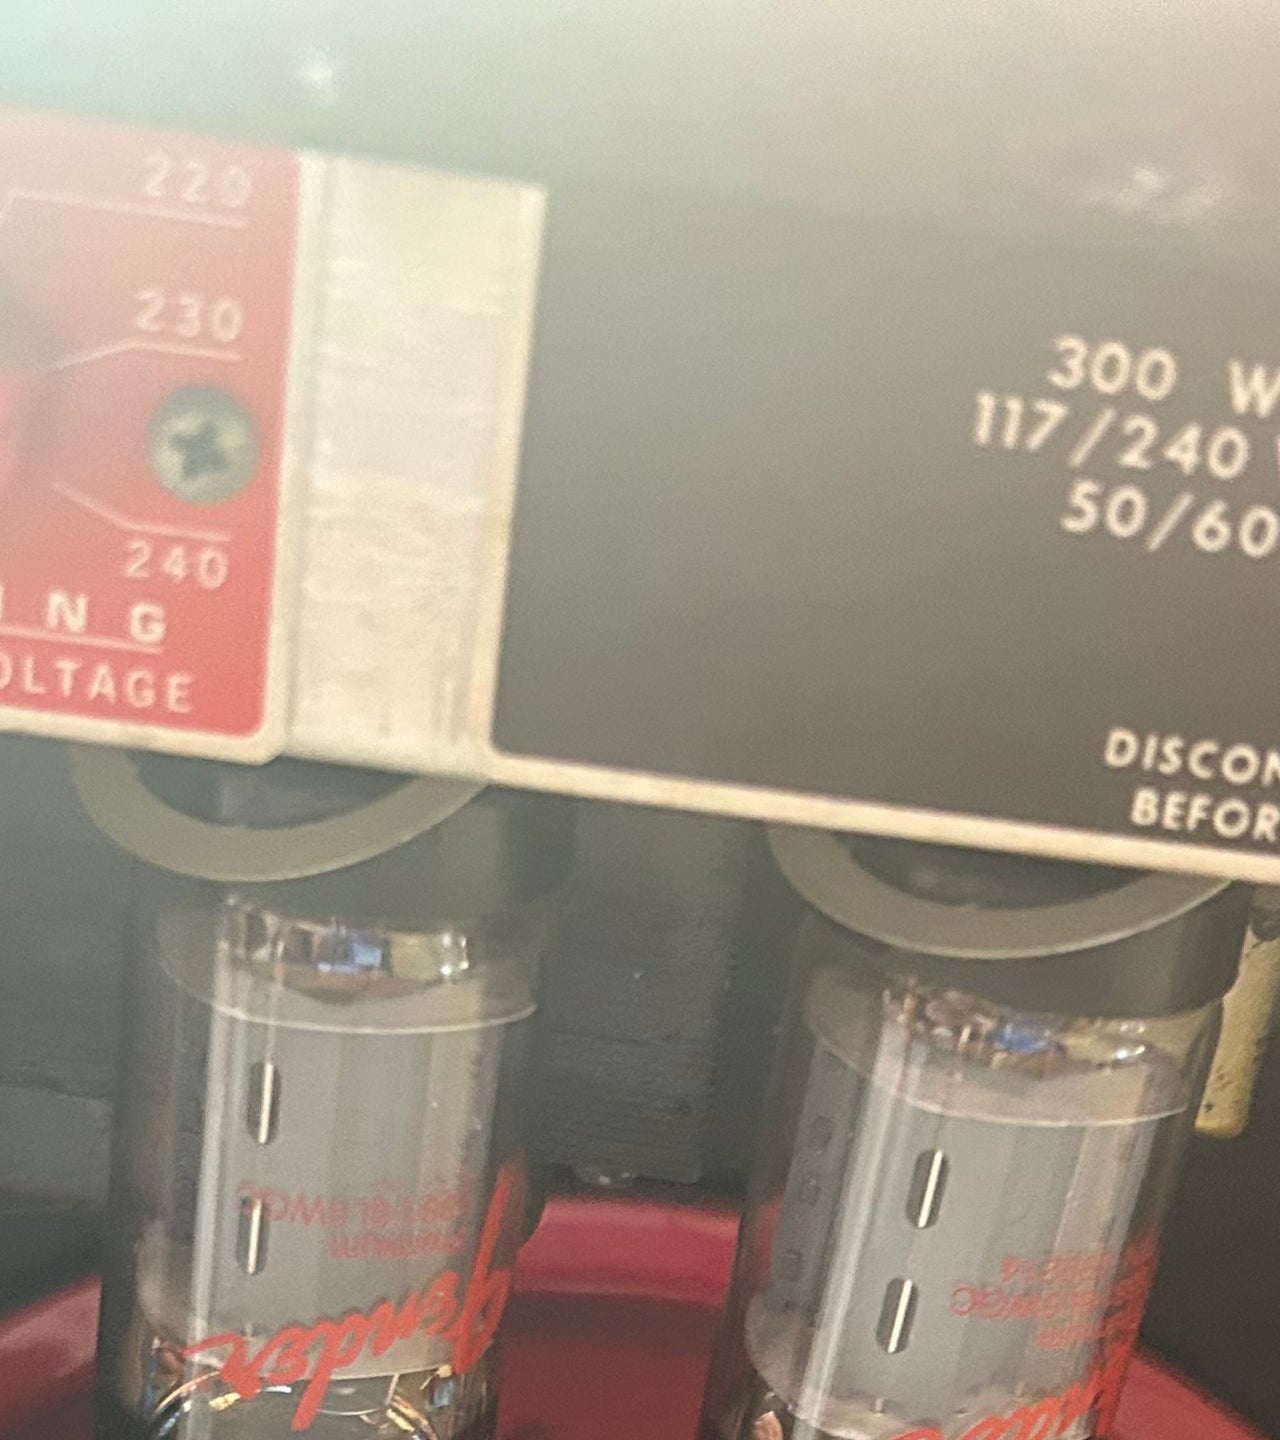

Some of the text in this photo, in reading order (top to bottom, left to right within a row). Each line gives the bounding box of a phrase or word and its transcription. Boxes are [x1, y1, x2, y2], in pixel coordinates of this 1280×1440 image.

[145, 155, 253, 208] 220
[135, 287, 244, 343] 230
[1047, 333, 1178, 401] 300
[974, 390, 1249, 480] 117/240
[1061, 478, 1280, 559] 50/60
[123, 540, 230, 590] 240
[182, 1158, 514, 1432] Fender
